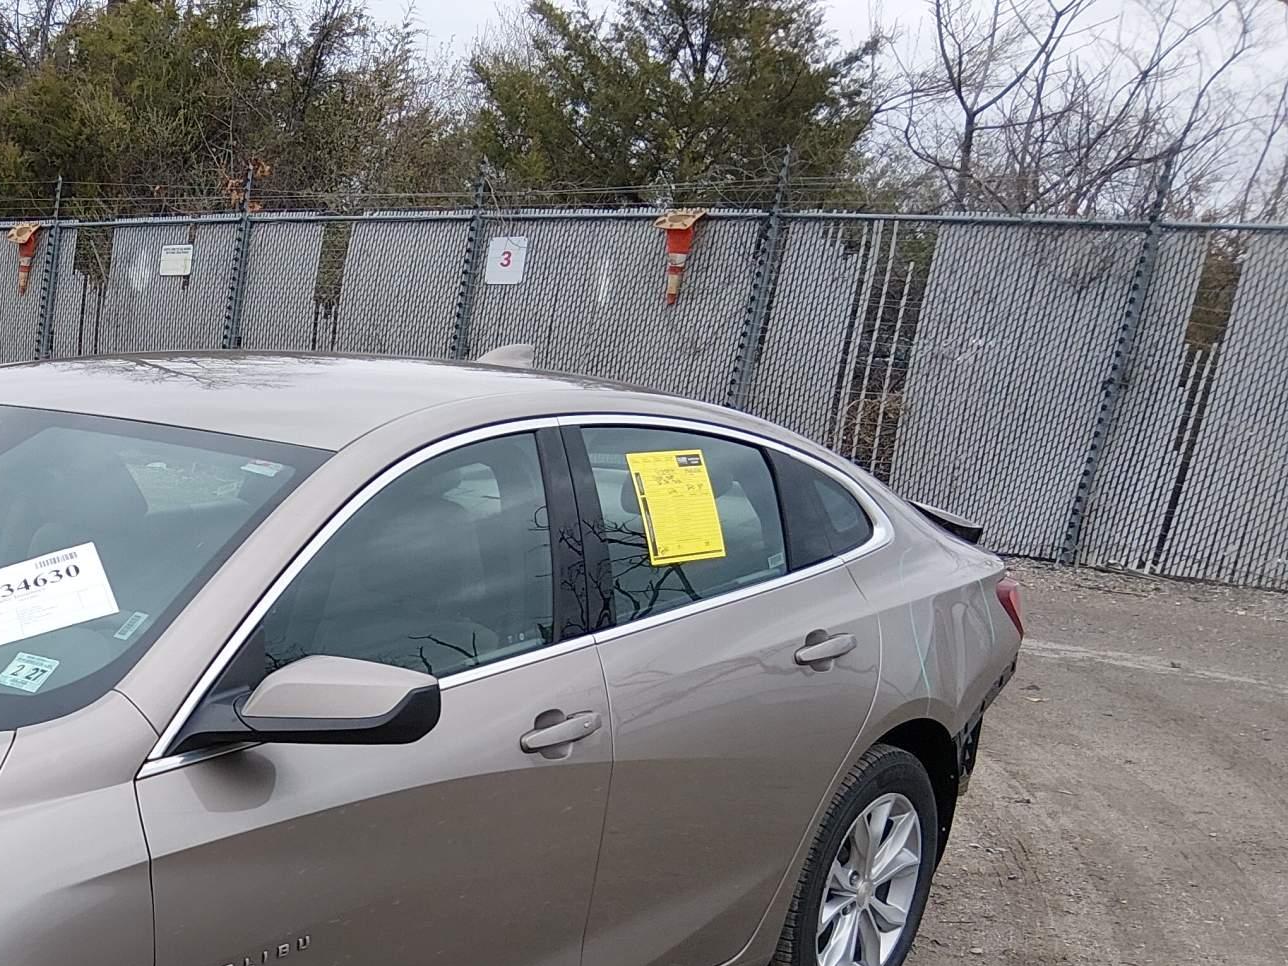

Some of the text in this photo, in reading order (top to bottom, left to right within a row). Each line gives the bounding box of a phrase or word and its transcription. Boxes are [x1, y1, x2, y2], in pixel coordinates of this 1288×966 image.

[500, 251, 511, 267] 3
[10, 664, 25, 677] 2
[25, 666, 48, 681] 27
